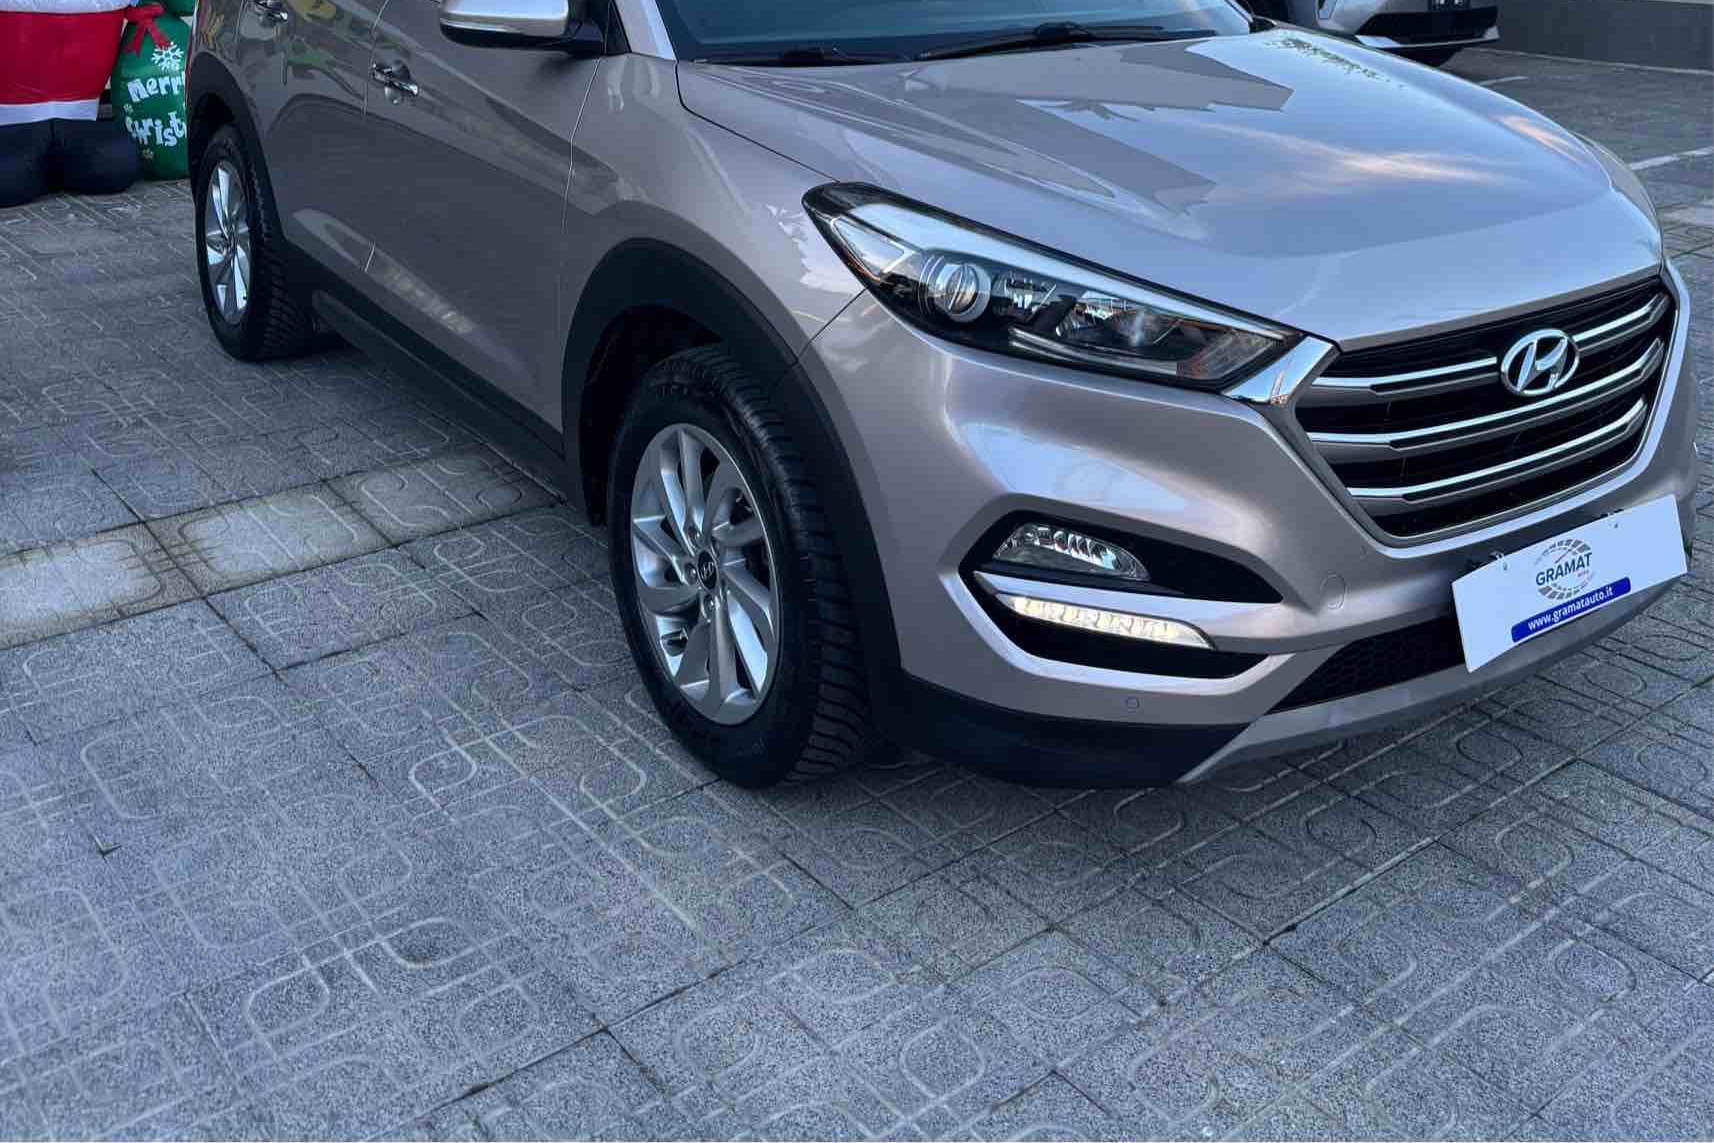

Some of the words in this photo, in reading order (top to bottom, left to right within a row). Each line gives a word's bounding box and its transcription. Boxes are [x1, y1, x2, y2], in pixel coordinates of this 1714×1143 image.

[127, 71, 186, 103] Merr
[1536, 553, 1593, 586] GRAMAT
[1528, 586, 1614, 631] www.gramatauto.it
